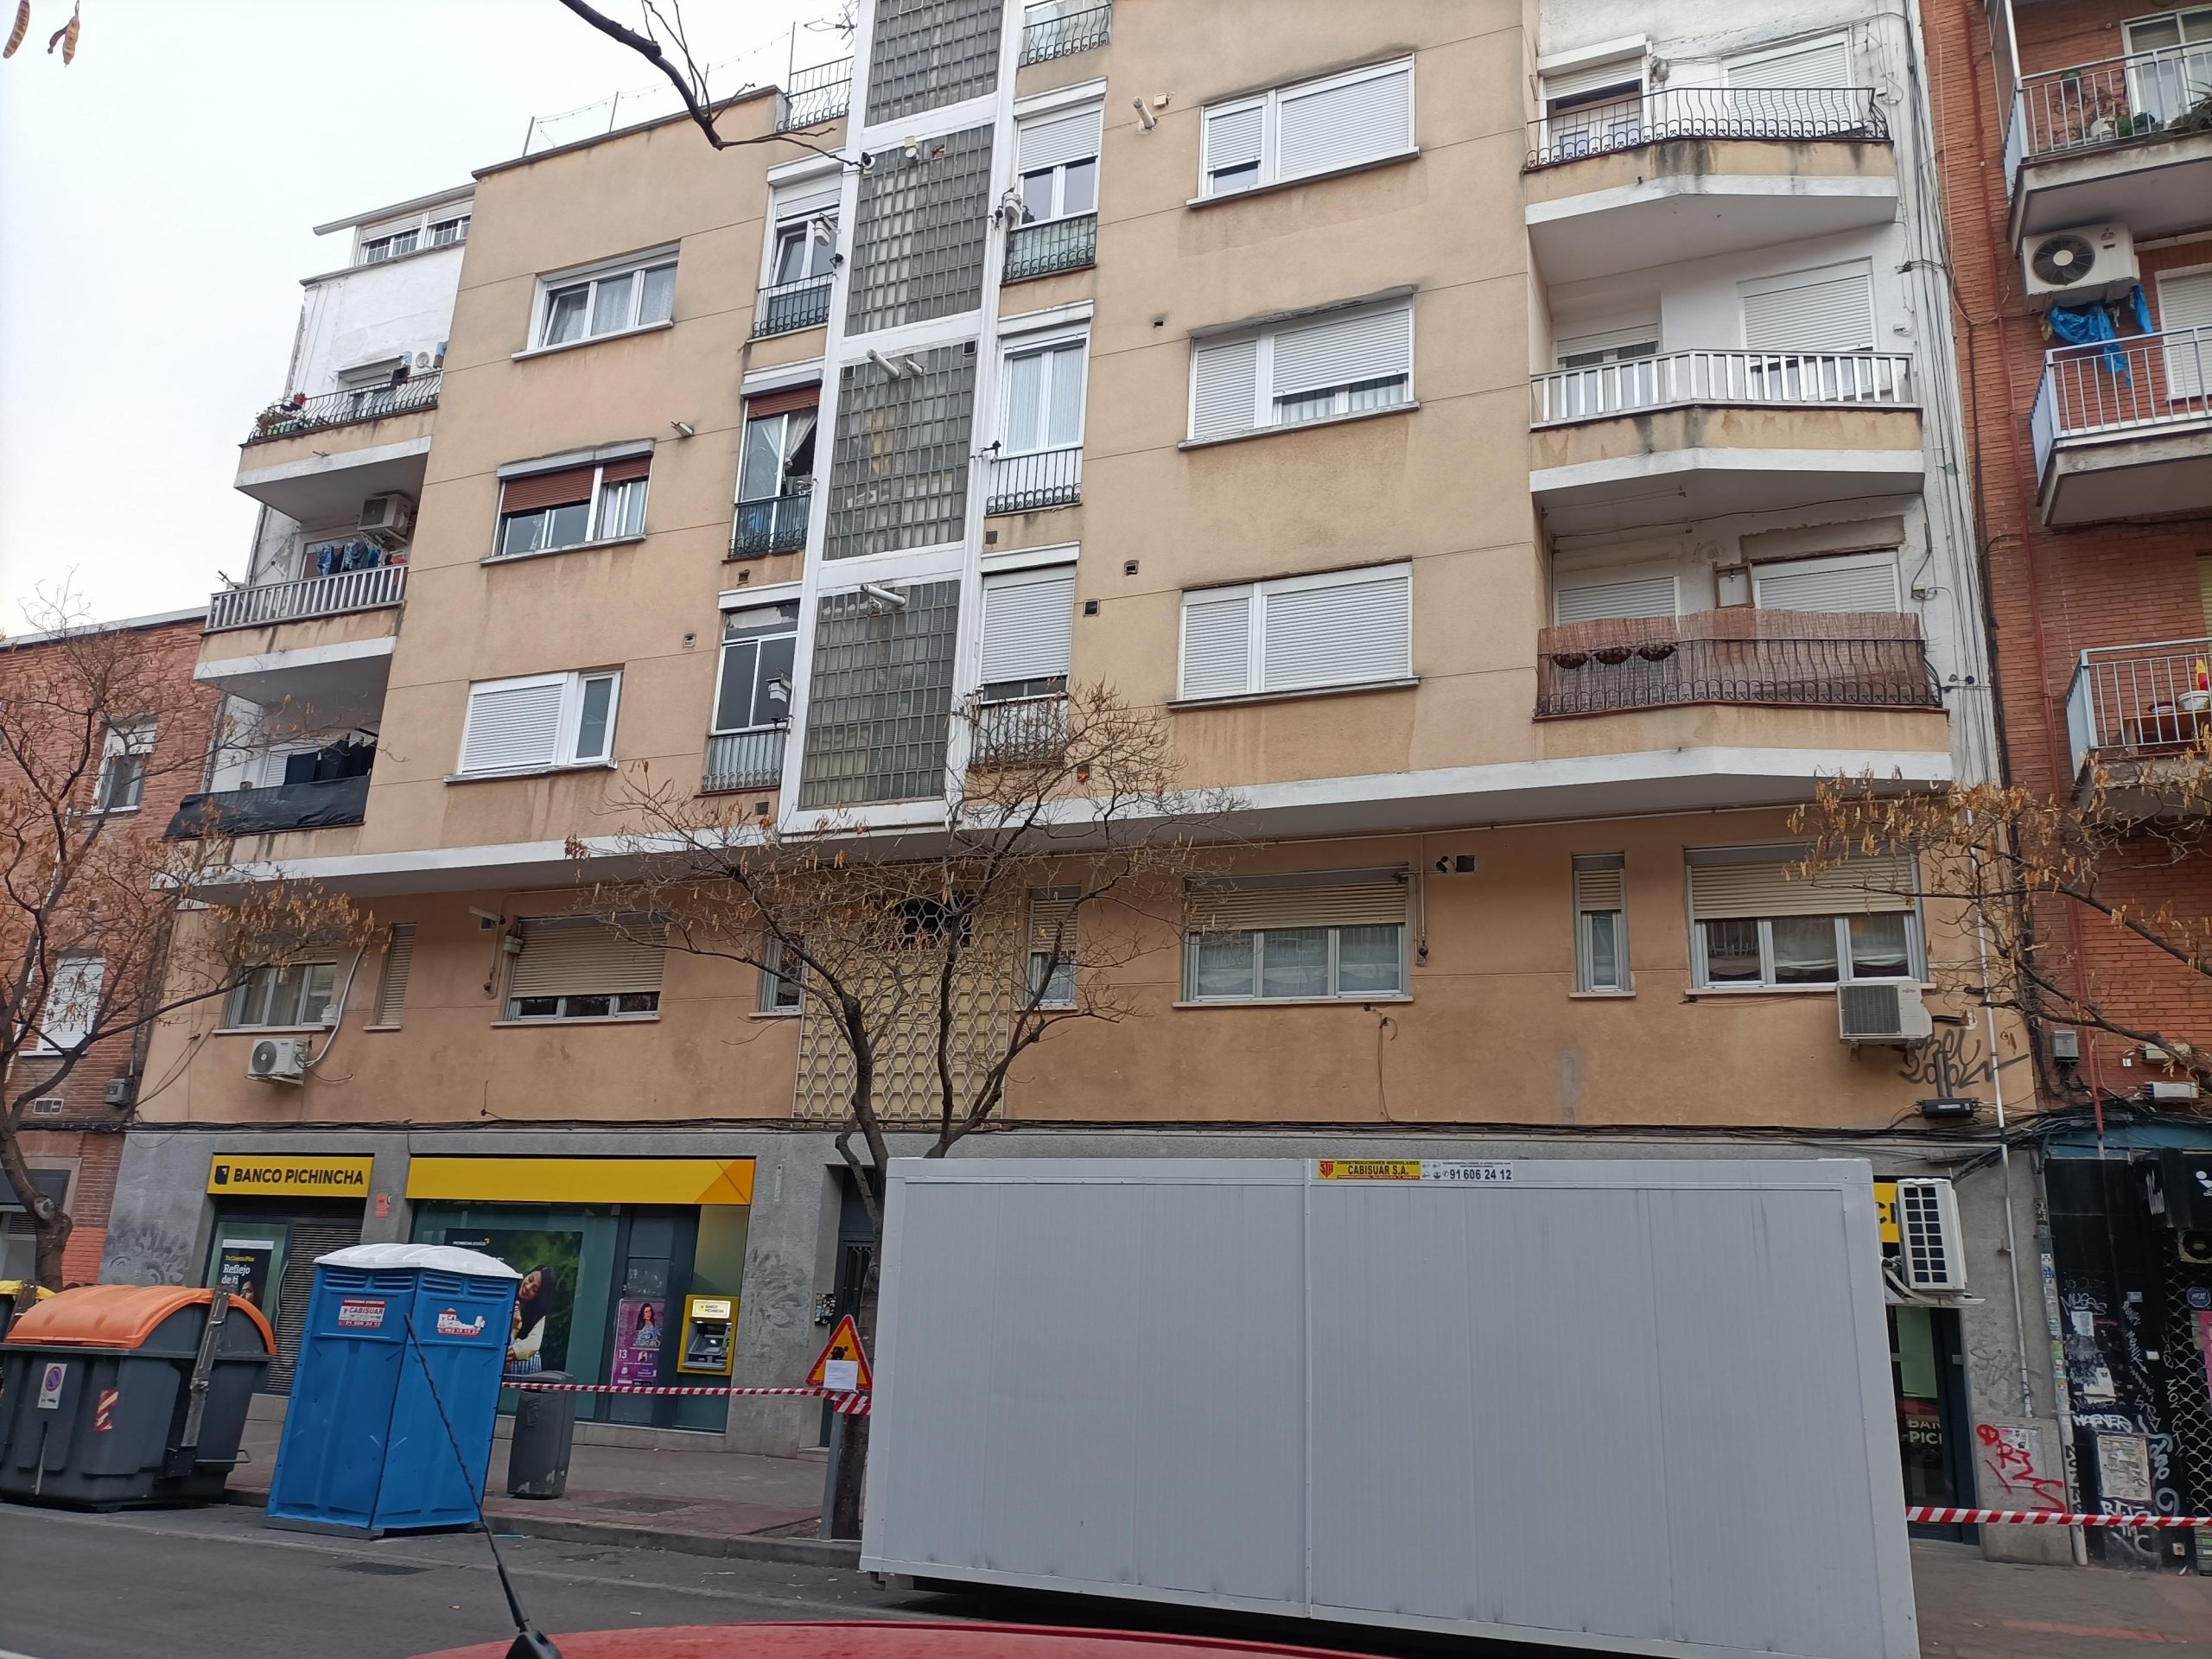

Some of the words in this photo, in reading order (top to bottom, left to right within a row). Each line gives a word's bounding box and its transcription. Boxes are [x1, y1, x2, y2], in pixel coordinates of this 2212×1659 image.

[1348, 1166, 1390, 1175] CABISUAR
[1392, 1166, 1409, 1175] S.A.
[1449, 1169, 1460, 1179] 91
[1463, 1169, 1481, 1179] 606
[1484, 1169, 1497, 1180] 24
[1500, 1169, 1512, 1180] 12
[233, 1168, 282, 1183] BANCO
[284, 1168, 364, 1185] PICHINCHA
[223, 1263, 251, 1276] Reflejo
[221, 1274, 232, 1284] de
[618, 1349, 628, 1359] 13
